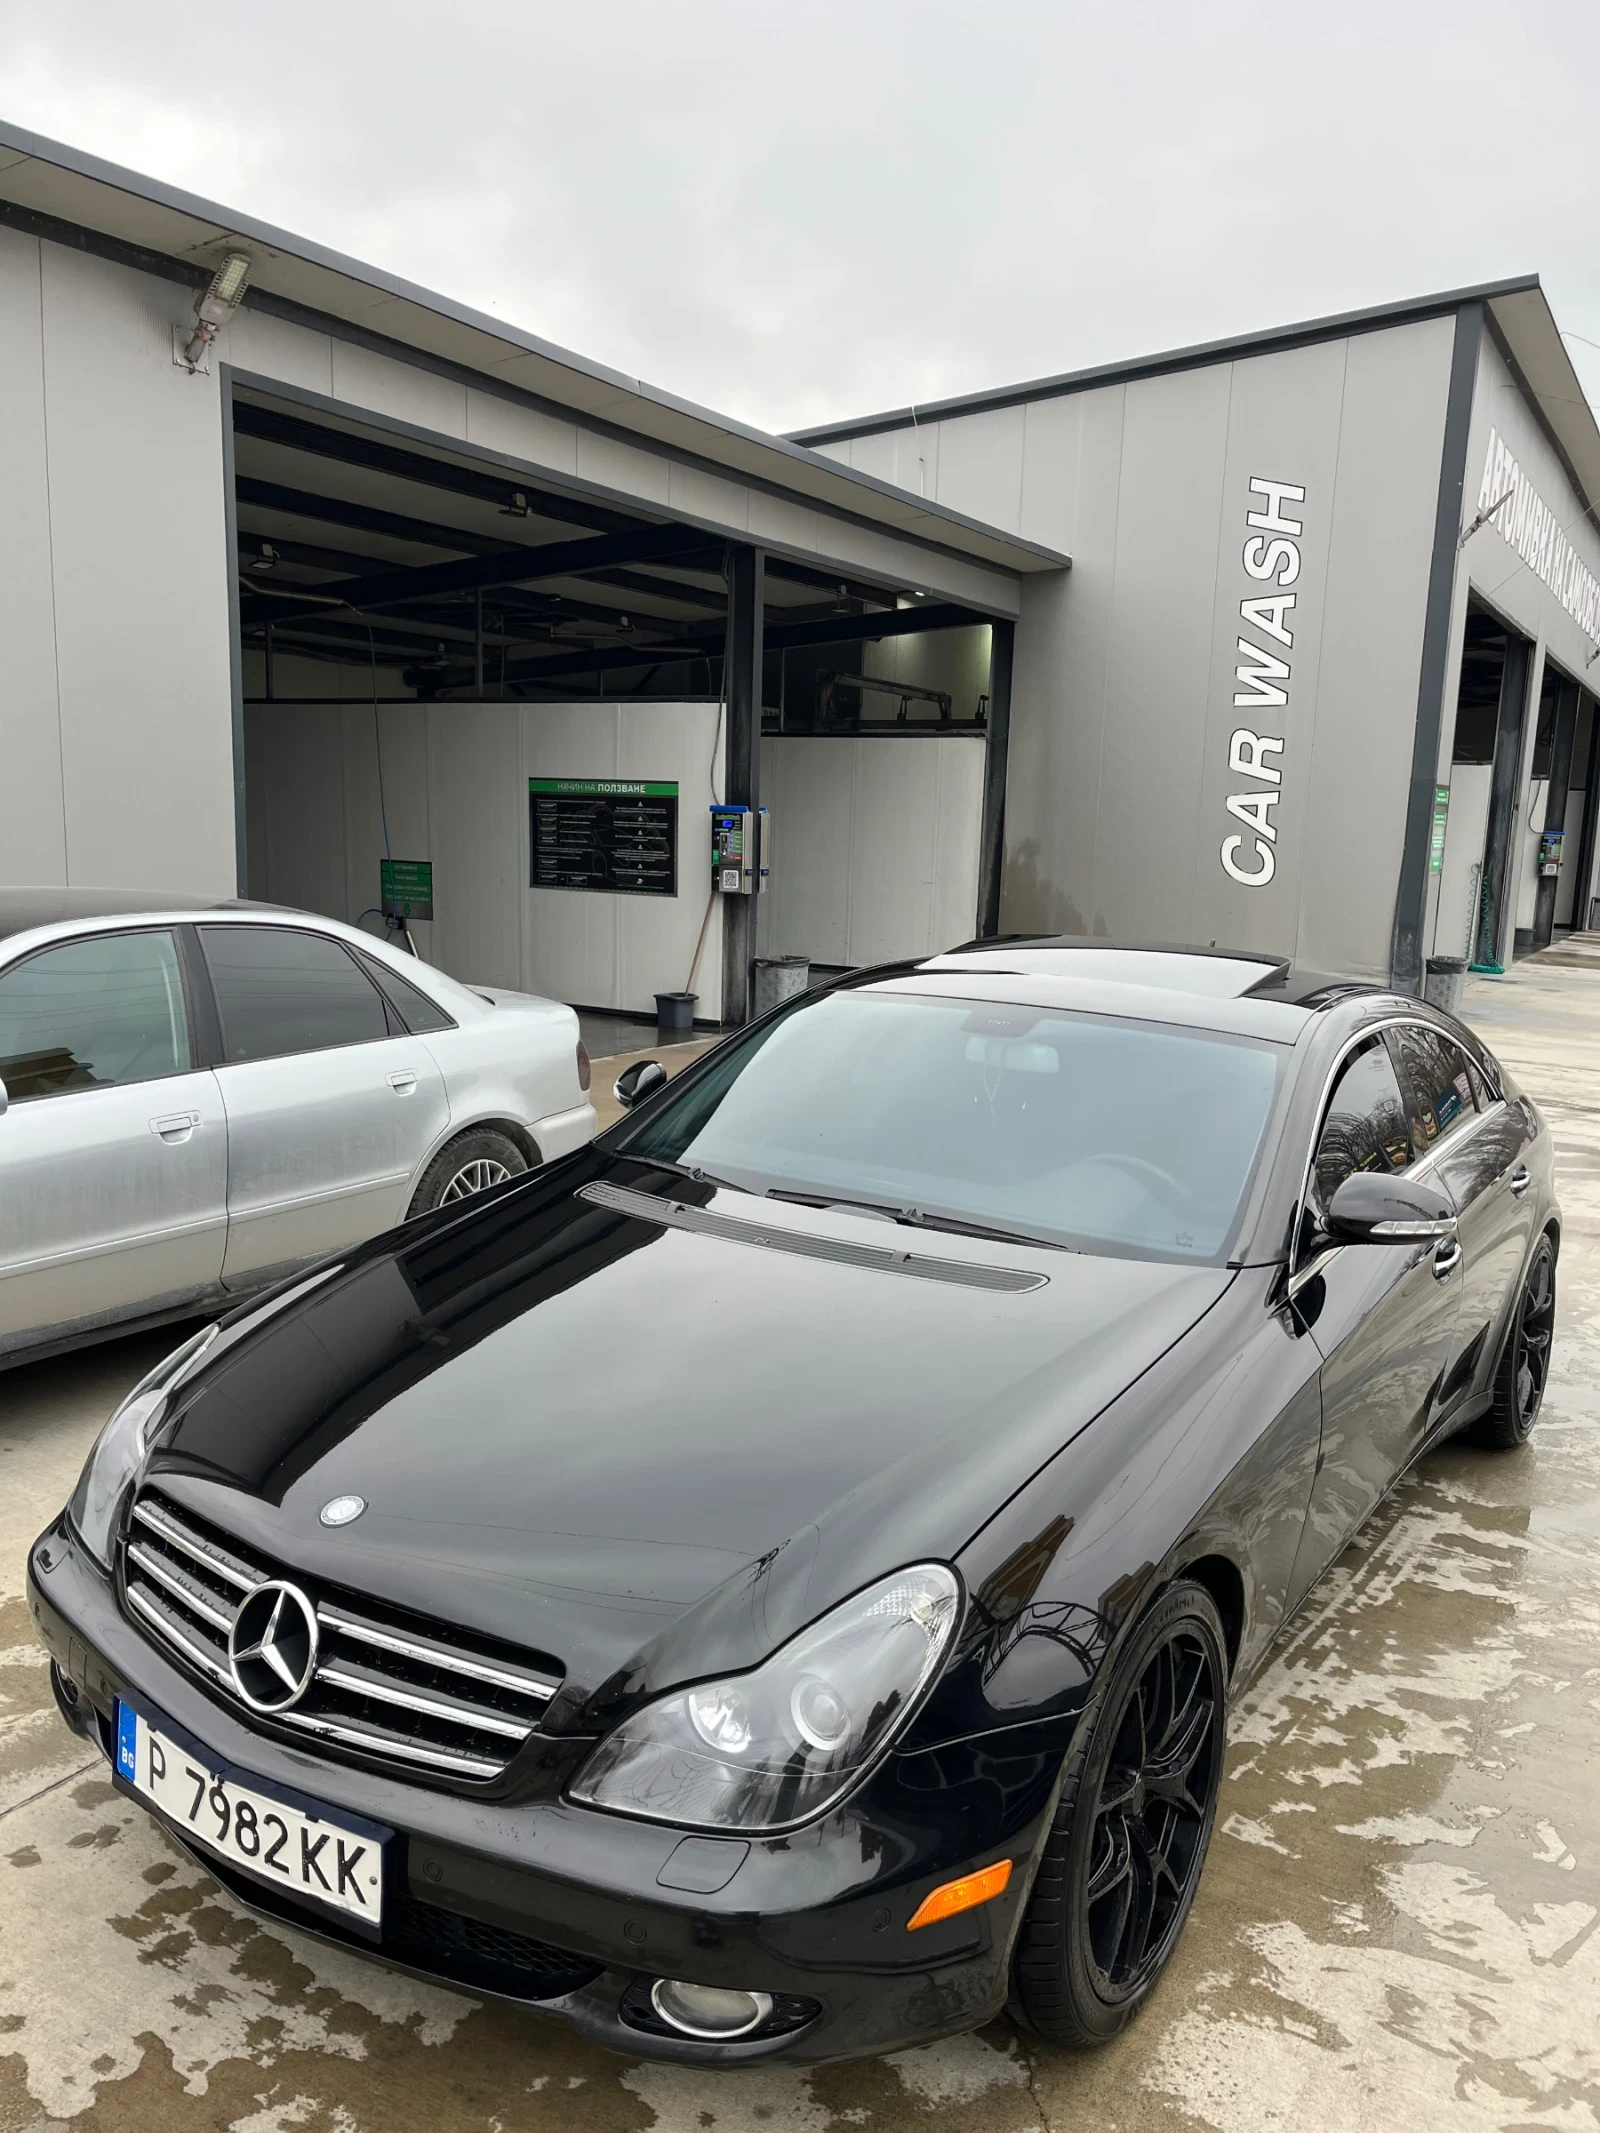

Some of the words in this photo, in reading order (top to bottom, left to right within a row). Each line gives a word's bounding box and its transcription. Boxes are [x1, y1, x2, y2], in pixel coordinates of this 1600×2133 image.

[1477, 424, 1556, 587] АВТОМИВКА
[1233, 476, 1306, 707] WASH
[557, 782, 582, 791] НАЧИН
[584, 783, 596, 792] НА
[597, 783, 646, 793] ПОЛЗВАНЕ
[1220, 728, 1285, 887] CAR
[121, 1746, 135, 1769] BG
[150, 1735, 165, 1791] P
